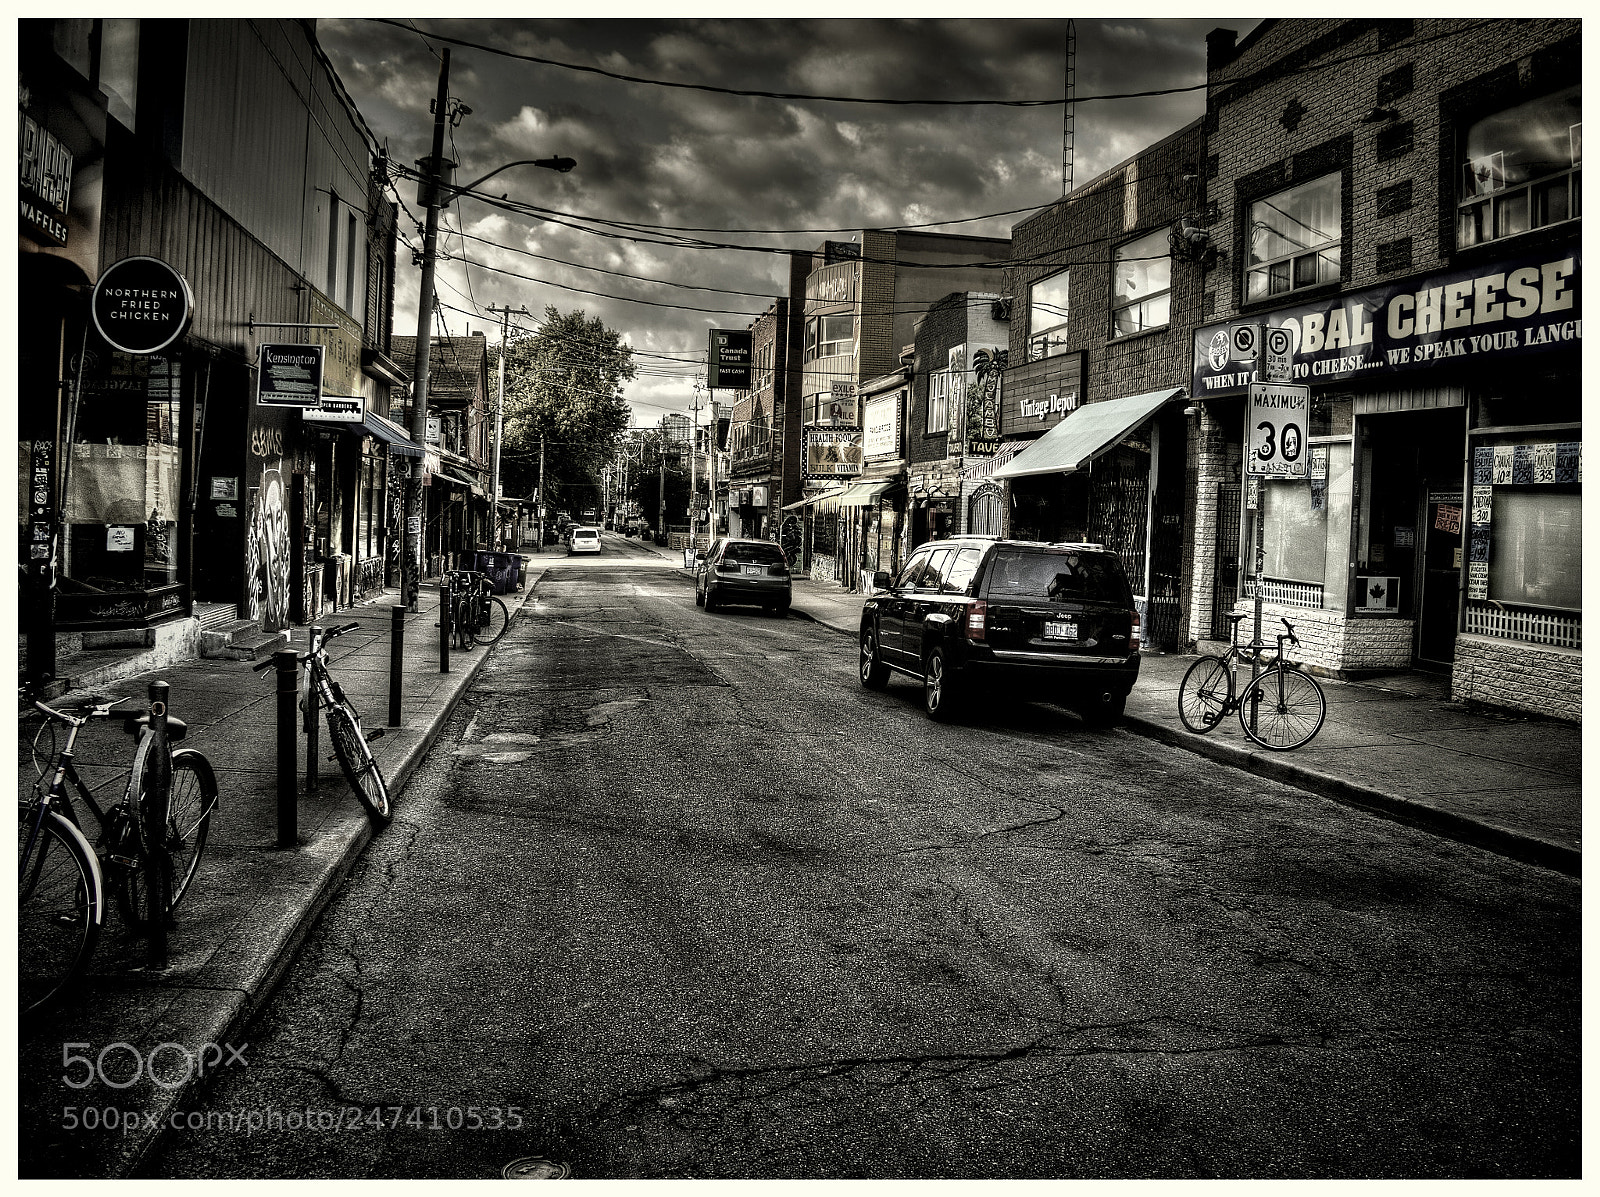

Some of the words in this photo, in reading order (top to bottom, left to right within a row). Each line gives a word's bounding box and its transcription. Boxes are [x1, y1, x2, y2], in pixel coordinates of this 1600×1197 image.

[20, 200, 67, 242] WAFFLES
[105, 288, 177, 299] NORTHERN
[1387, 257, 1574, 340] CHEESE
[121, 300, 160, 310] FRIED
[110, 311, 169, 321] CHICKEN
[716, 336, 727, 345] TD
[720, 347, 748, 355] Canada
[1237, 371, 1250, 386] IT
[1293, 362, 1309, 379] TO
[1387, 348, 1410, 366] WE
[1413, 338, 1465, 362] SPEAK
[1470, 330, 1519, 354] YOUR
[1523, 320, 1582, 347] LANGU
[266, 349, 316, 368] Kensington
[1020, 398, 1049, 420] Vintage
[1050, 391, 1078, 417] Depot
[810, 433, 833, 443] HEALTH
[835, 433, 852, 443] FOOD
[1257, 421, 1302, 462] 30
[972, 441, 1000, 453] TAVE
[809, 464, 834, 473] BULK
[1056, 612, 1072, 620] Jeep
